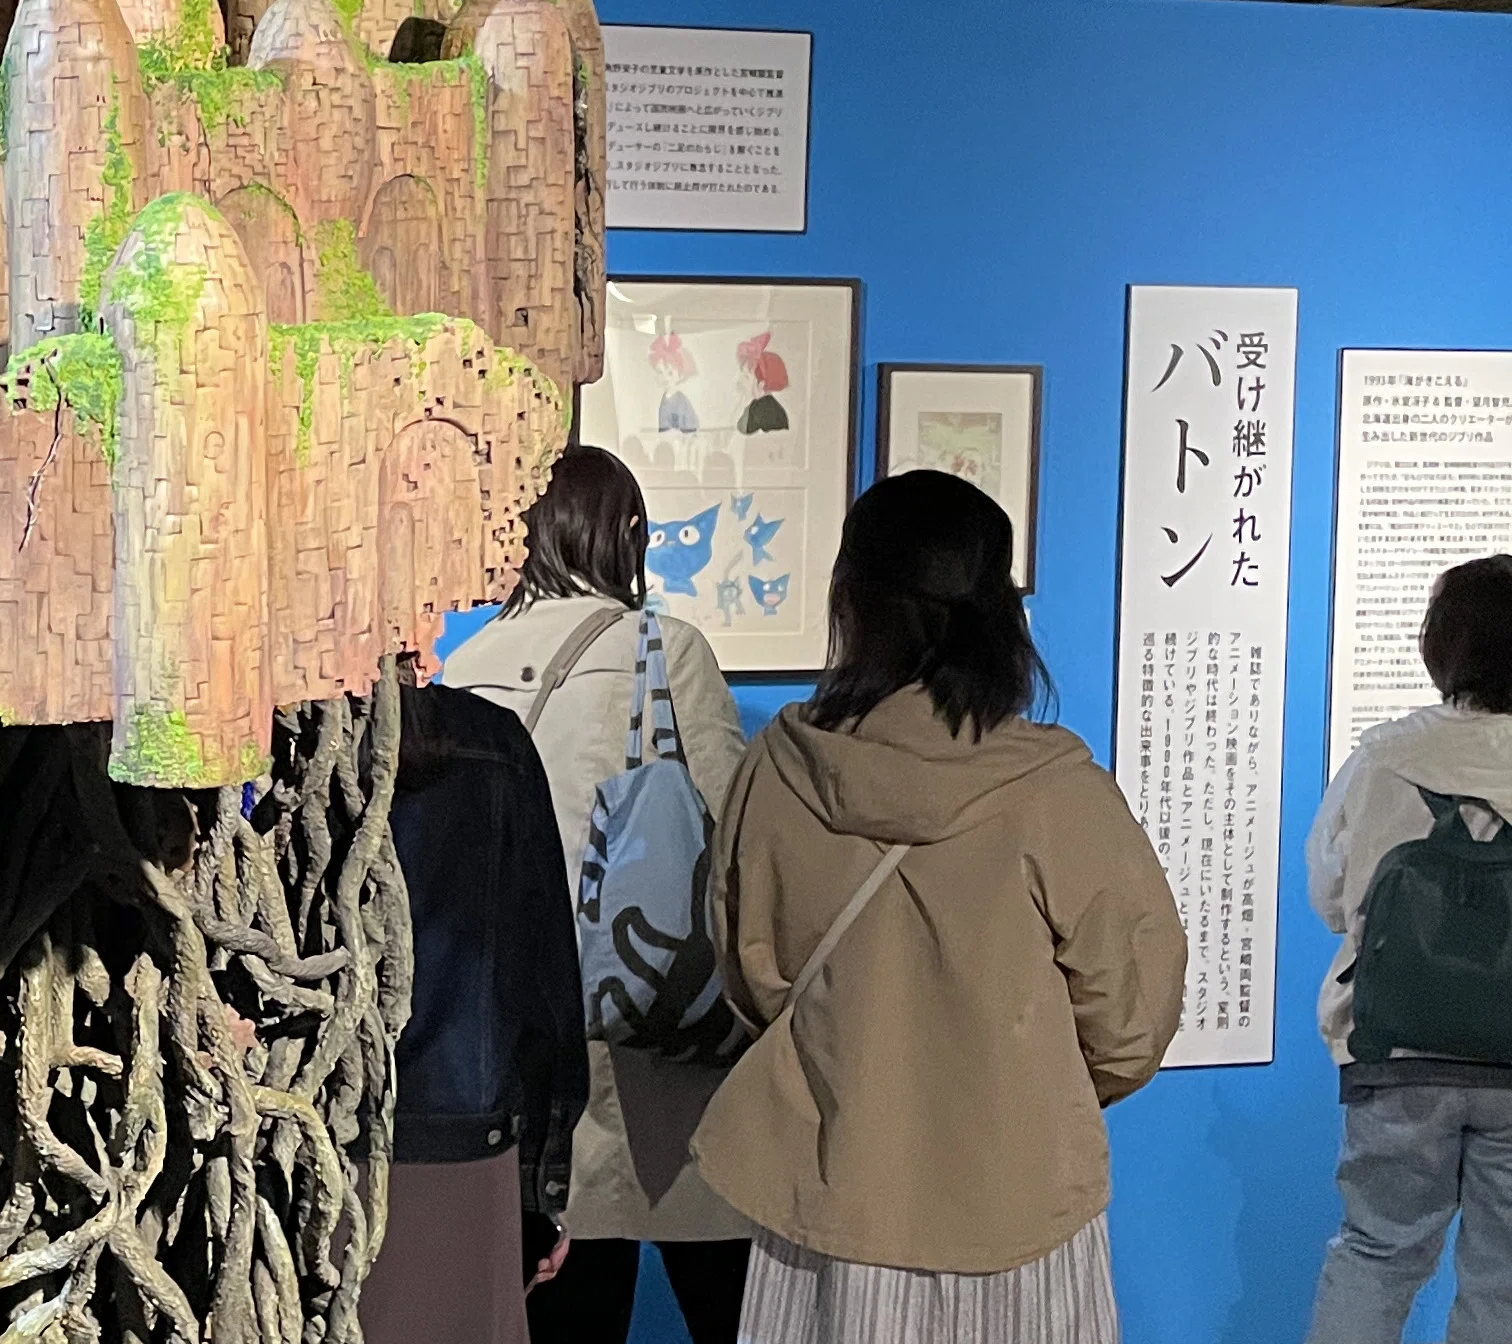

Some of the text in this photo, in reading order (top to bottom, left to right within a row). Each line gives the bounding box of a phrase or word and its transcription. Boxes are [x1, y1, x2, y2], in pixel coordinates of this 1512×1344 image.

[1151, 328, 1229, 588] バトン
[1231, 331, 1268, 587] 受け継がれた
